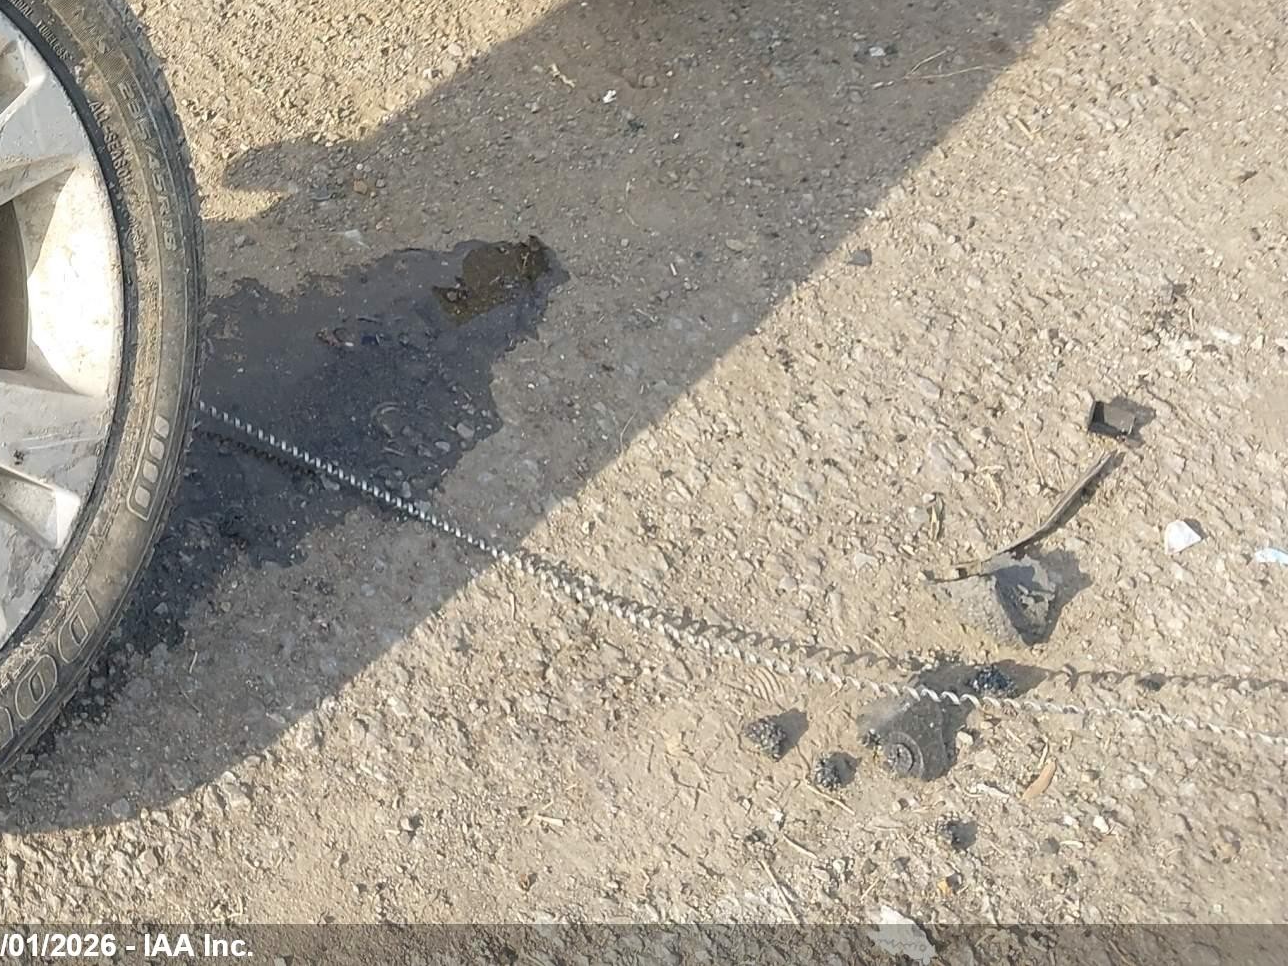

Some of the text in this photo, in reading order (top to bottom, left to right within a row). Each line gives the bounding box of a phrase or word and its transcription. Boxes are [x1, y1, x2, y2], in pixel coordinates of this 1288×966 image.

[36, 19, 70, 61] TUBELESS
[88, 97, 133, 187] ALL-SEASON
[118, 81, 177, 251] 235/45R18
